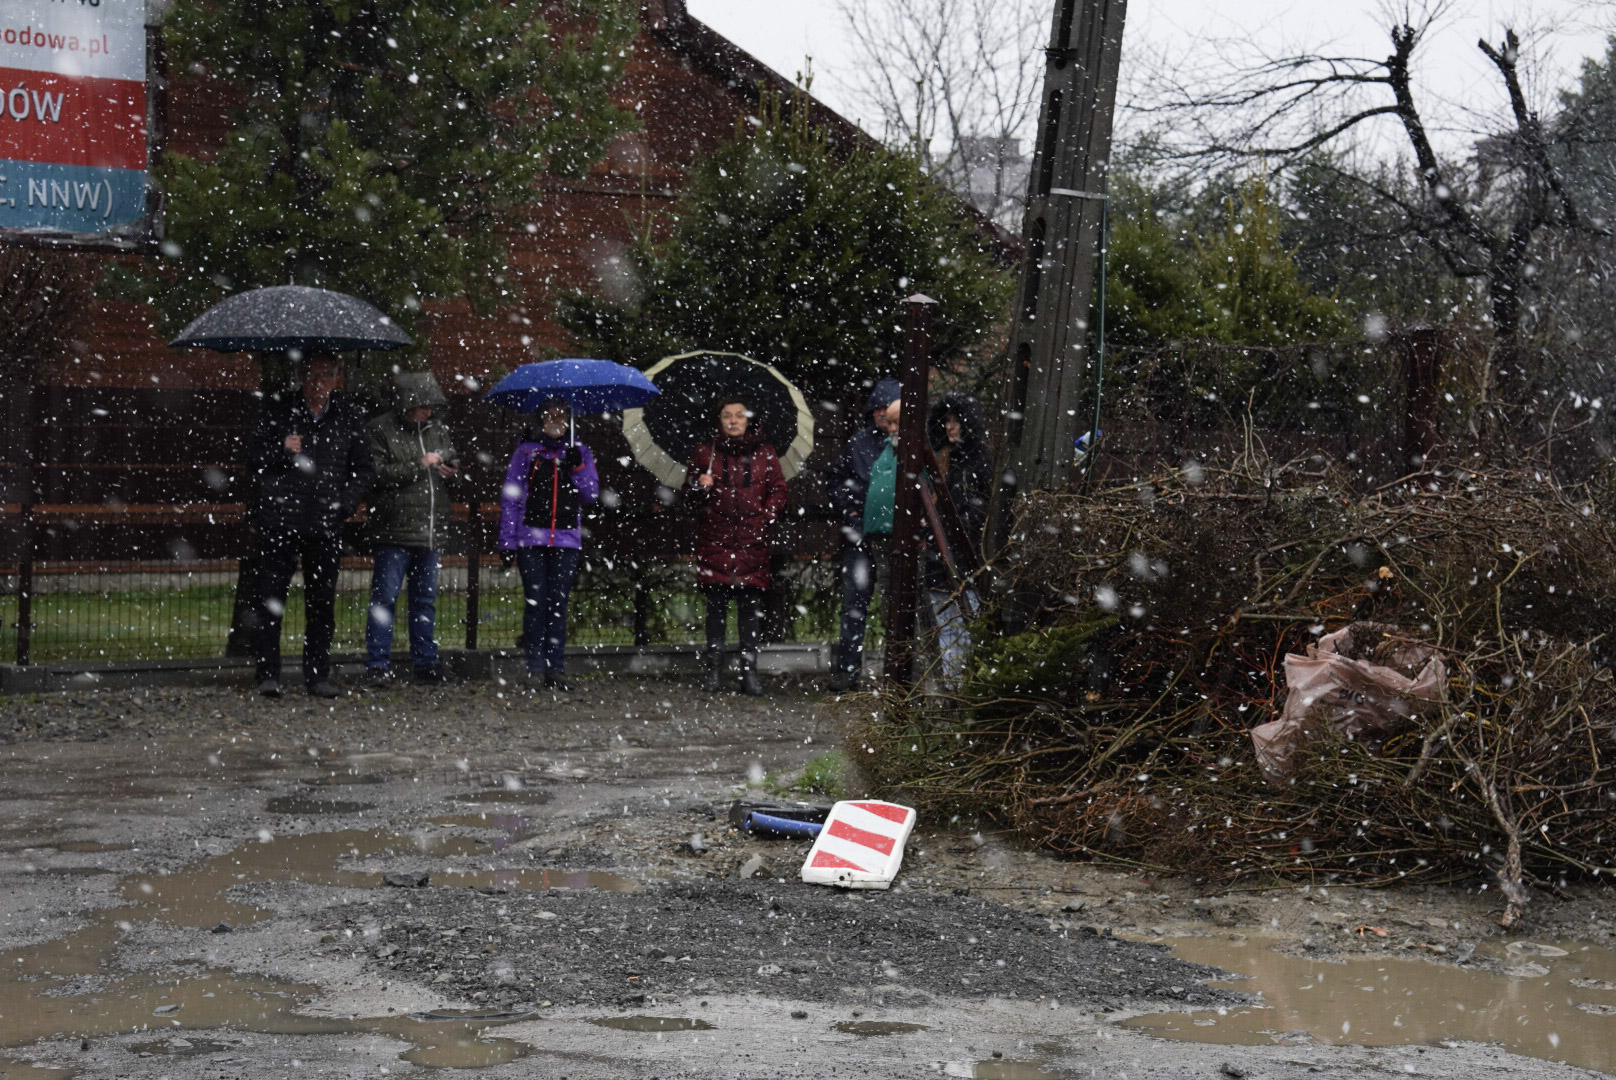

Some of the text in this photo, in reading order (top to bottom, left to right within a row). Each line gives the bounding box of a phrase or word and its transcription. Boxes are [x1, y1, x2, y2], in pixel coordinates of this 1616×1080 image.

[0, 26, 109, 57] odowa.pl
[0, 82, 64, 124] ÓW
[28, 177, 113, 219] NNW)
